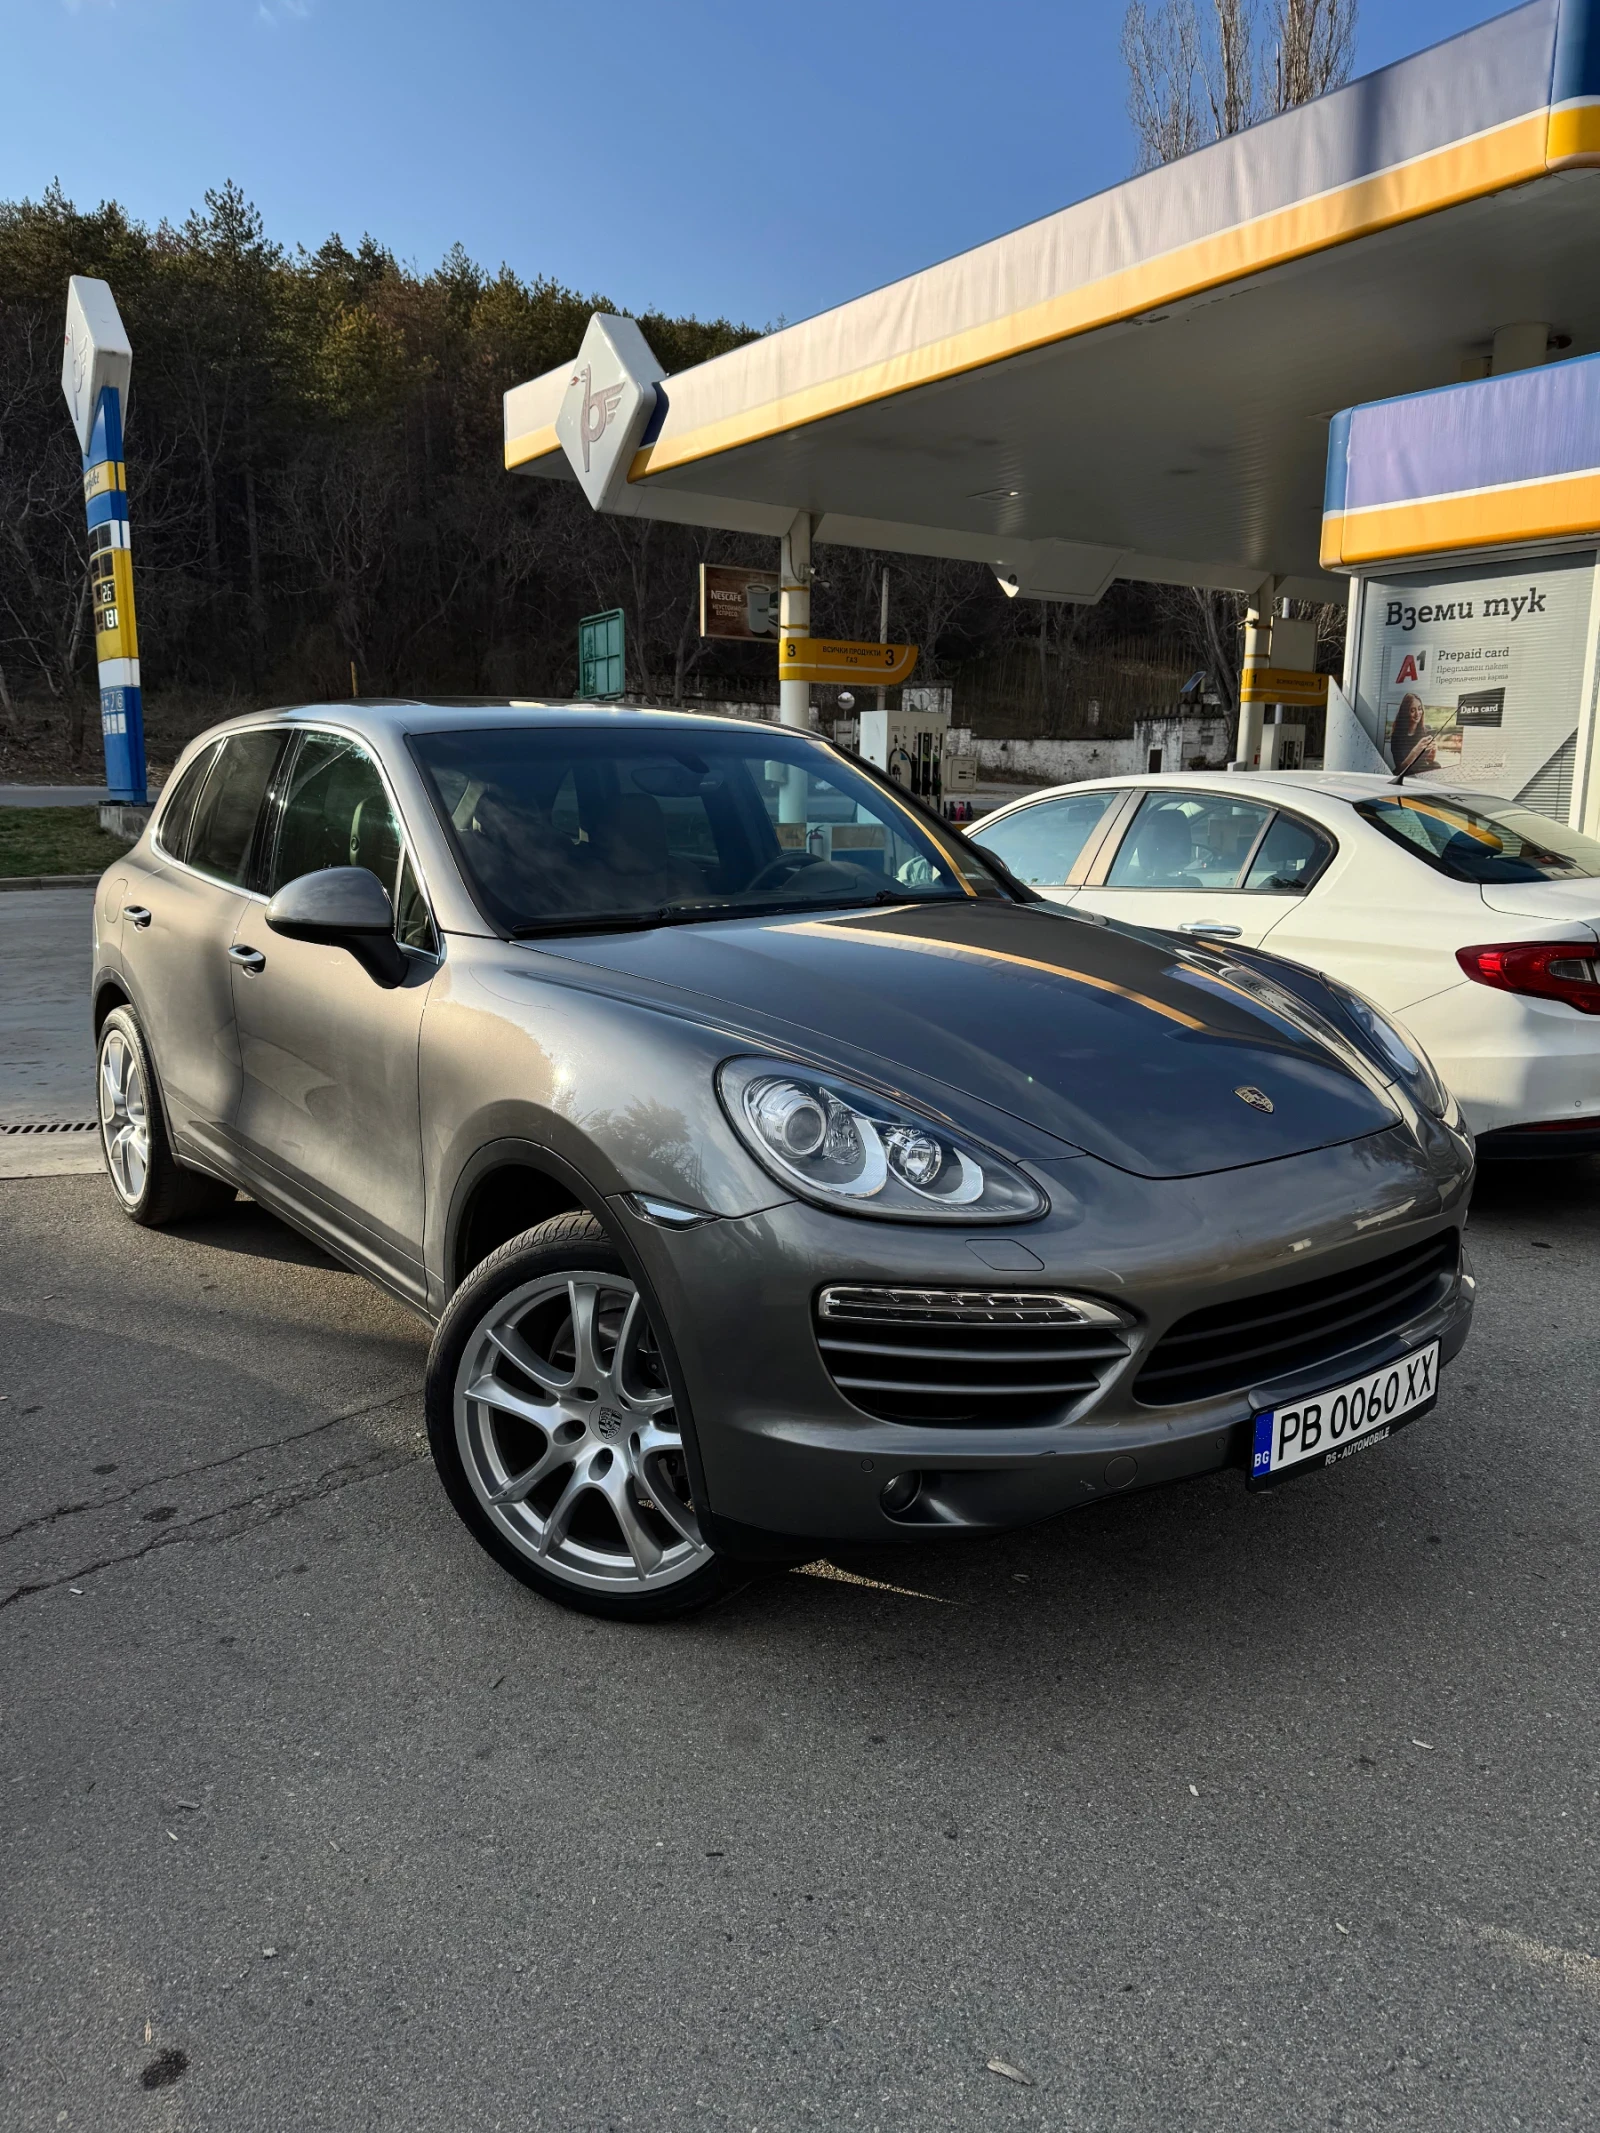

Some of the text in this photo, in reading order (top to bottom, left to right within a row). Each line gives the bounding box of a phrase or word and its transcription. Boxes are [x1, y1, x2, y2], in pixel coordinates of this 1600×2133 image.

[1385, 587, 1547, 631] Вземи тук
[787, 644, 796, 657] 3
[822, 646, 881, 656] ВСИЧКИ ПРОДУКТИ
[885, 649, 895, 666] 3
[1438, 647, 1509, 662] Prepaid card
[1396, 650, 1426, 684] A1
[1252, 673, 1257, 684] 1
[1318, 677, 1322, 690] 1
[1460, 704, 1498, 714] Data card
[1278, 1350, 1435, 1461] PB 0060 XX
[1254, 1452, 1269, 1467] BG
